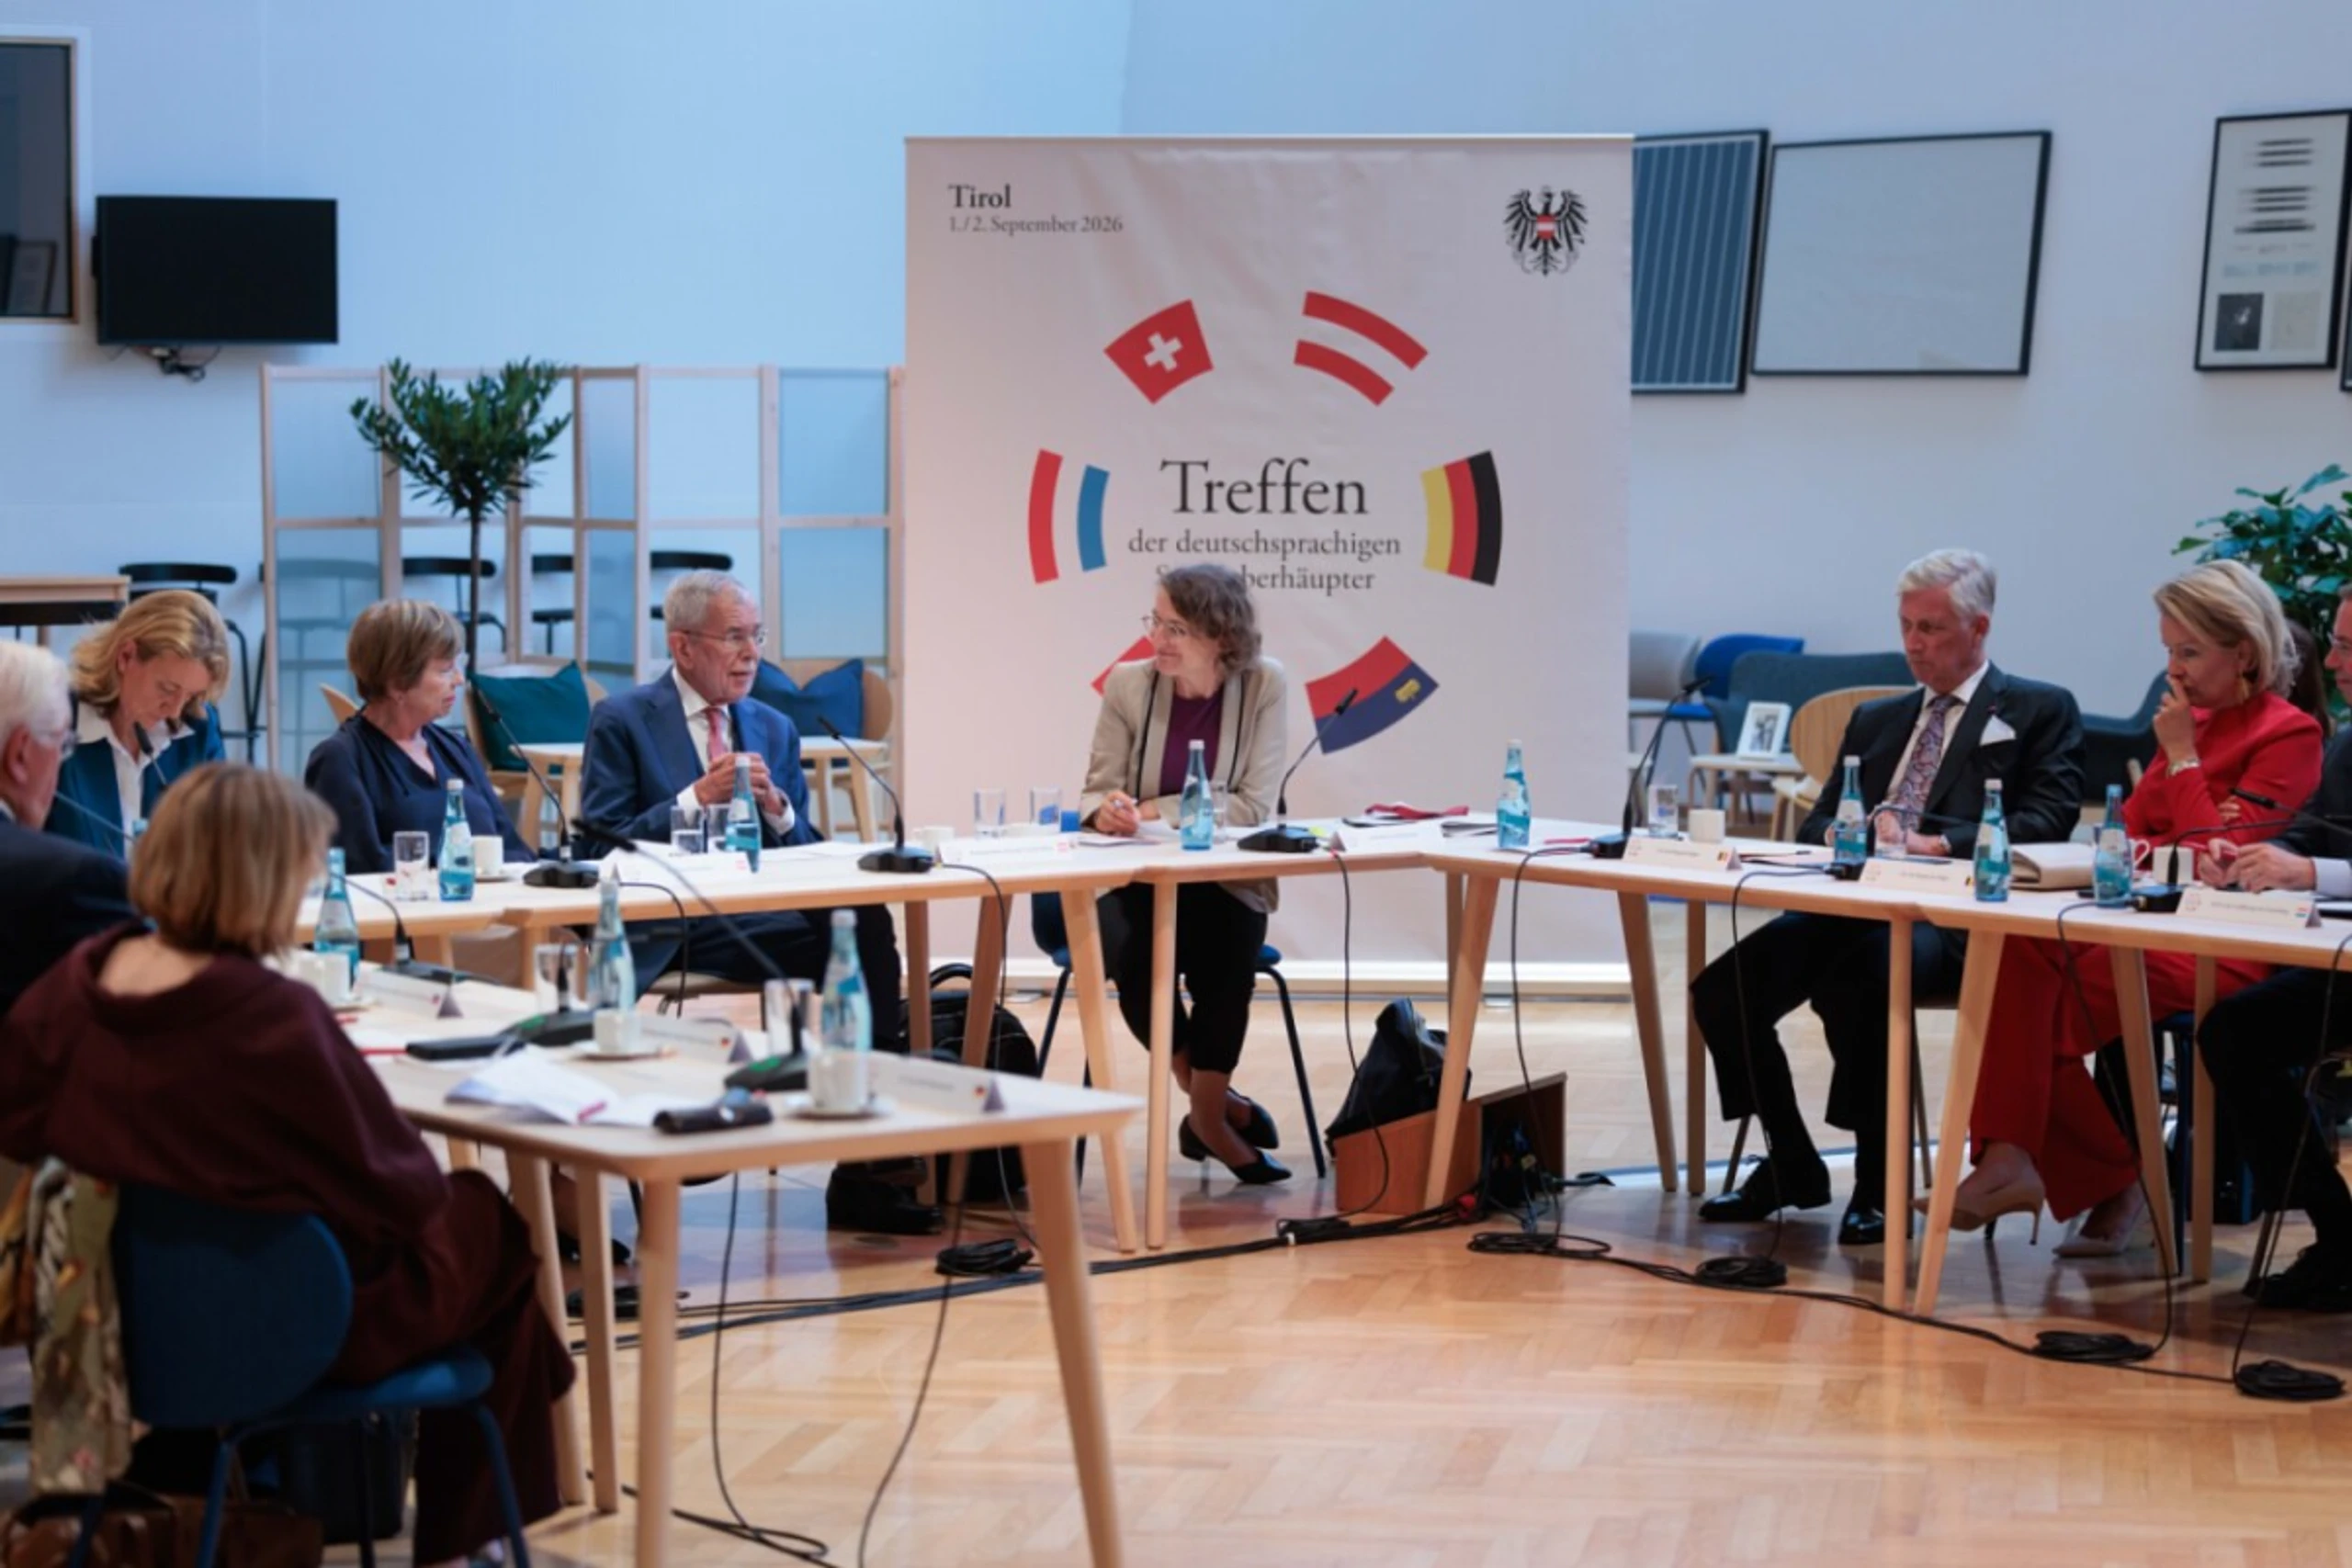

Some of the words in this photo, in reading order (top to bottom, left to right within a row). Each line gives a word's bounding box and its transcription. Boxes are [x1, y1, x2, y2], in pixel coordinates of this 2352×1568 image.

[948, 183, 1012, 209] Tirol
[989, 214, 1078, 237] September
[1080, 215, 1123, 232] 2026
[1159, 457, 1369, 514] Treffen
[1128, 529, 1168, 553] der
[1176, 529, 1401, 562] deutschsprachigen
